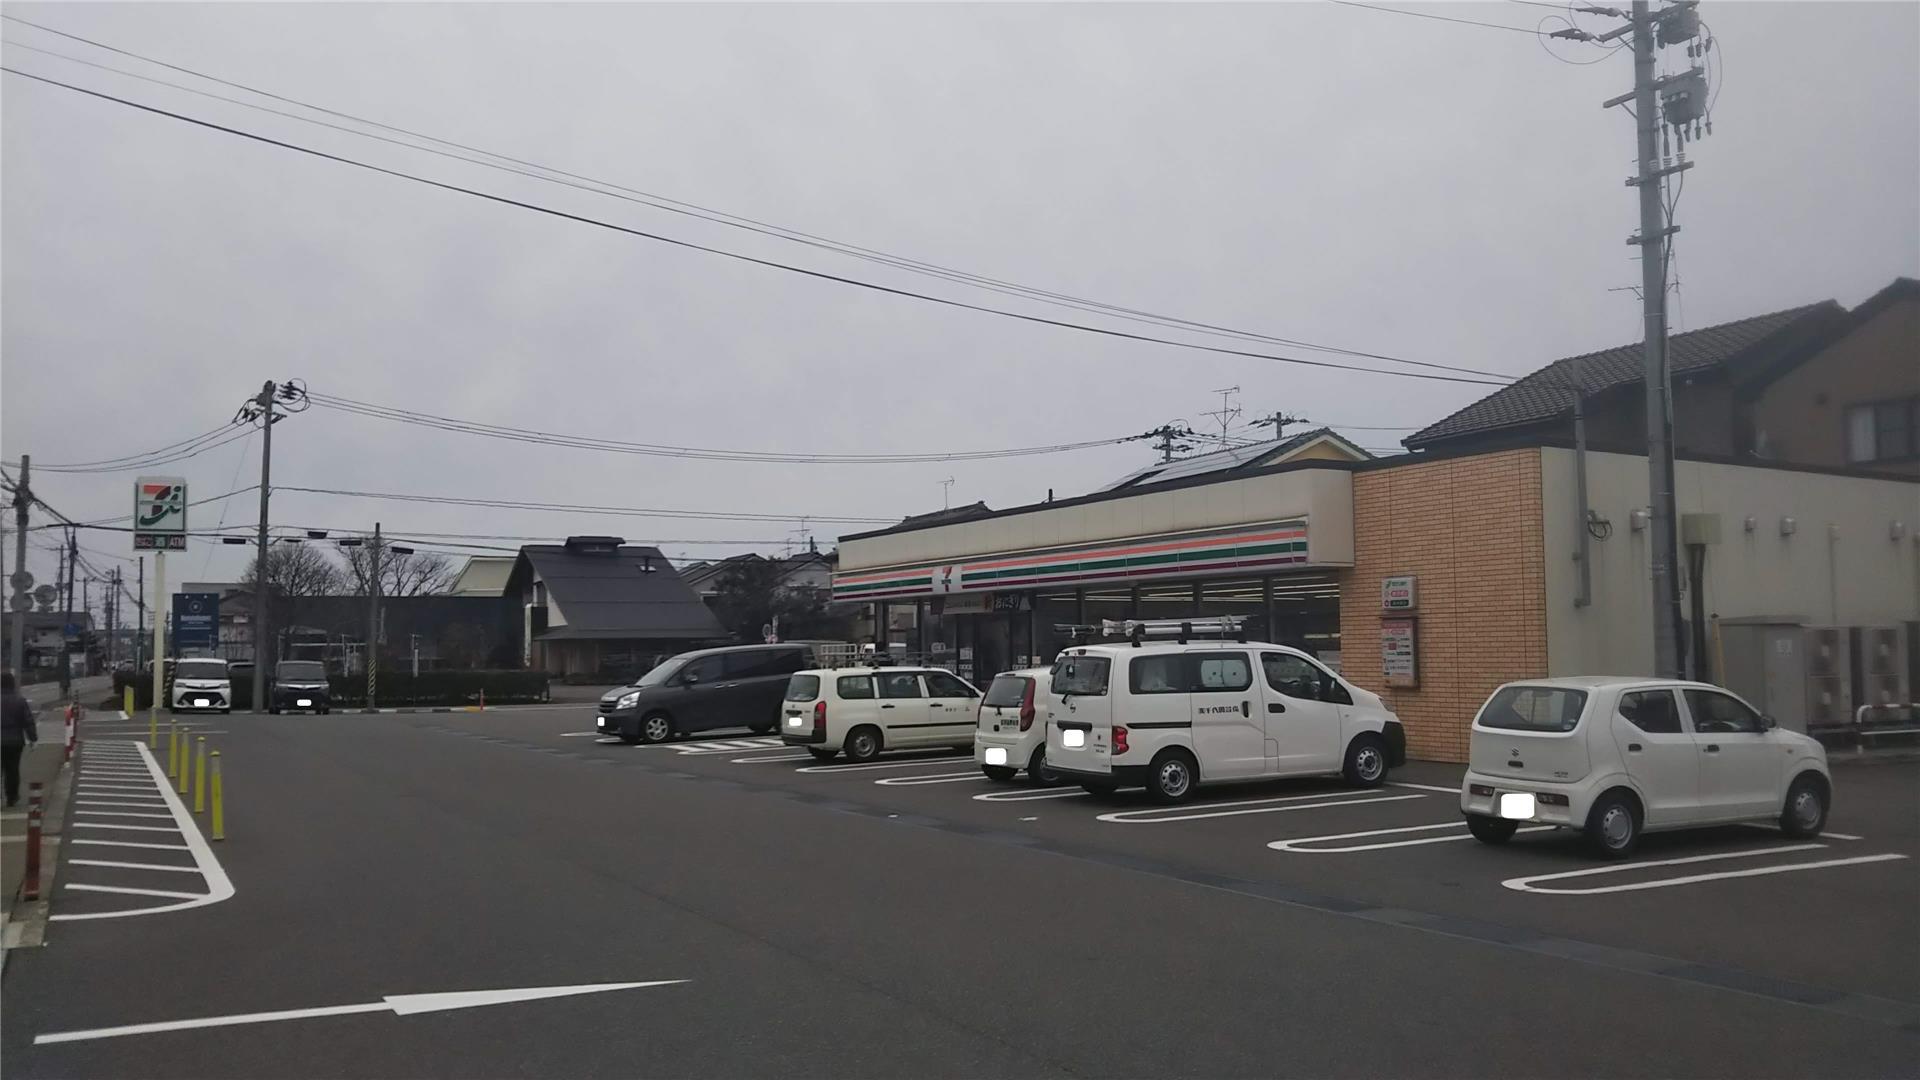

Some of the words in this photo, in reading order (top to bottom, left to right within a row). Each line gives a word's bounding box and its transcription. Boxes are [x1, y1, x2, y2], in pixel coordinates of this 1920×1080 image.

[169, 536, 185, 547] ATM
[995, 594, 1019, 609] おにぎり
